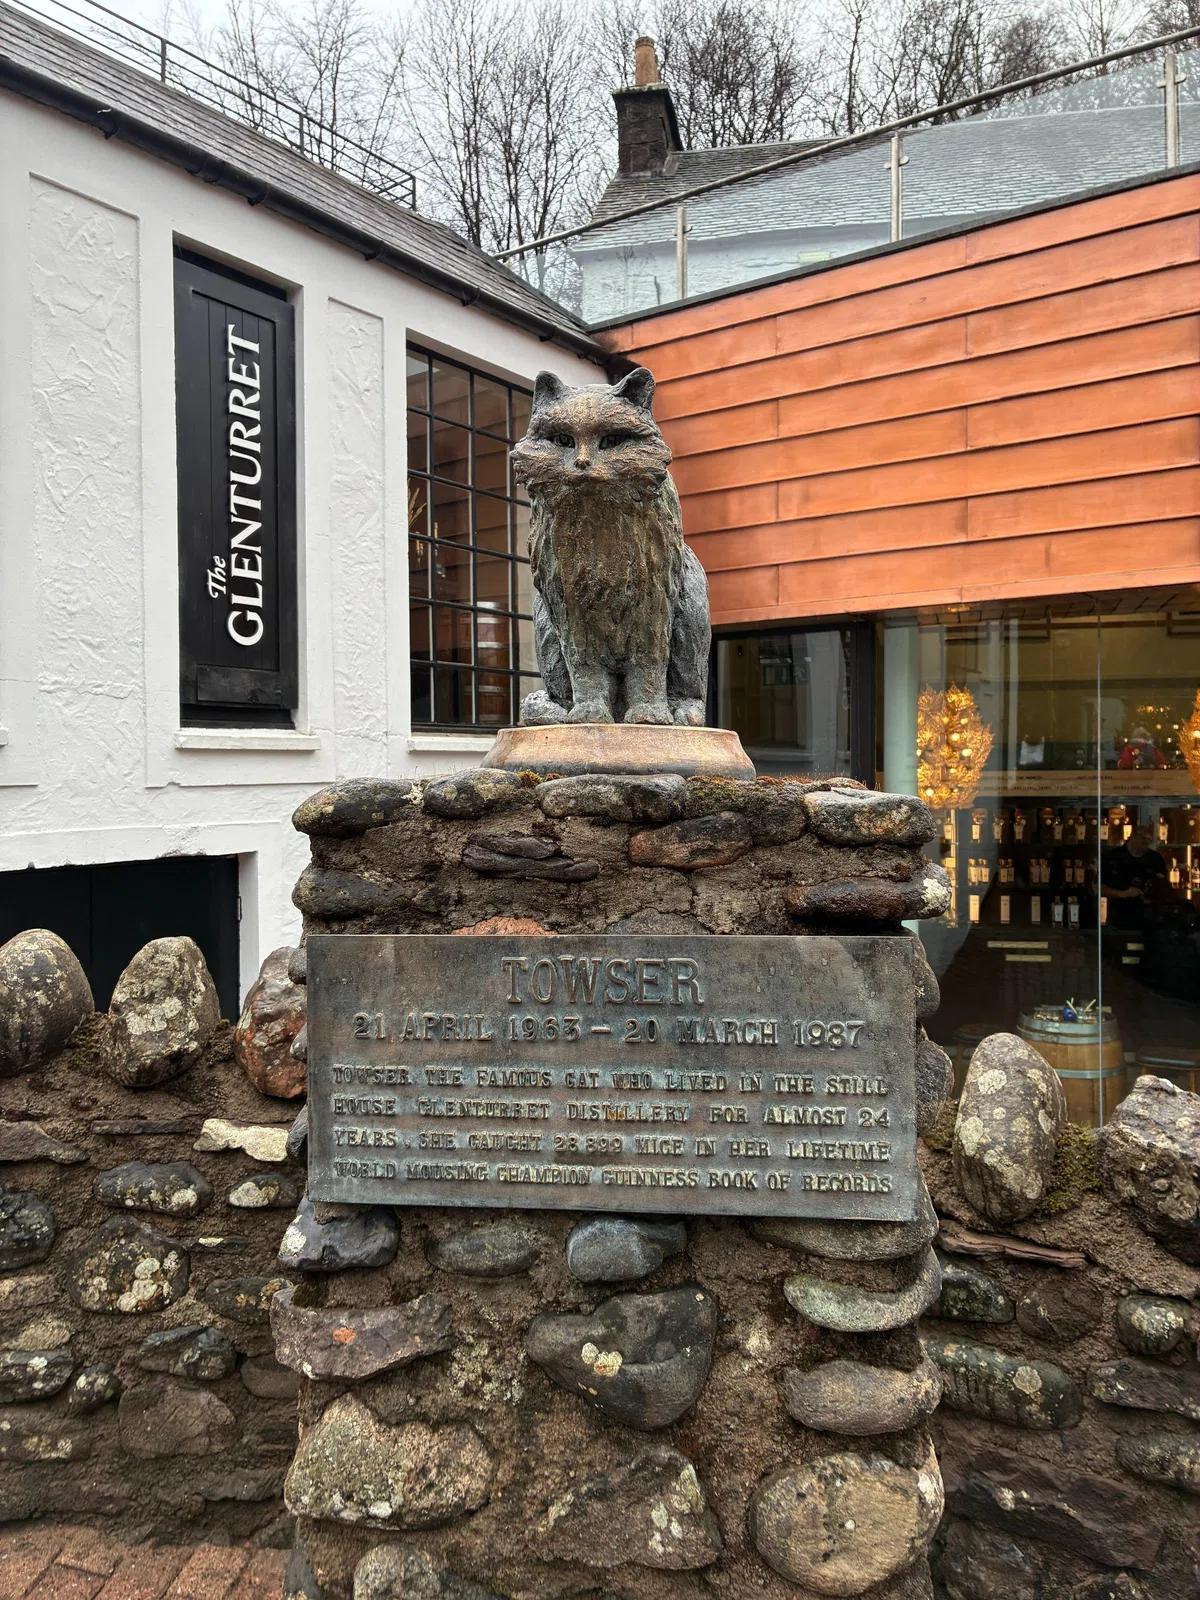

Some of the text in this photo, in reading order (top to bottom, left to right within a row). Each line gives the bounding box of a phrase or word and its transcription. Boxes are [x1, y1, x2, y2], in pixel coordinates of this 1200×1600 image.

[227, 324, 264, 646] GLENTURRET
[207, 555, 227, 599] The
[501, 956, 705, 1006] TOWSER
[353, 1012, 385, 1040] 21
[401, 1012, 492, 1041] APRIL
[509, 1015, 580, 1041] 1963
[624, 1018, 660, 1044] 20
[678, 1017, 779, 1047] MARCH
[794, 1019, 866, 1049] 1987
[333, 1064, 888, 1096] TOWSER THE FAMOUS CAT WHO LIVED IN THE STILL
[333, 1097, 890, 1128] HOUSE GLENTURRET DISTILLERY FOR ALMOST 24
[418, 1130, 457, 1149] SHE
[468, 1132, 543, 1152] CAUGHT
[635, 1135, 684, 1156] MICE
[696, 1138, 717, 1157] IN
[728, 1138, 771, 1158] HER
[787, 1140, 892, 1162] LIFETIME
[334, 1158, 892, 1194] WORLD MOUSING CHAMPION GUINNESS BOOK OF RECORDS
